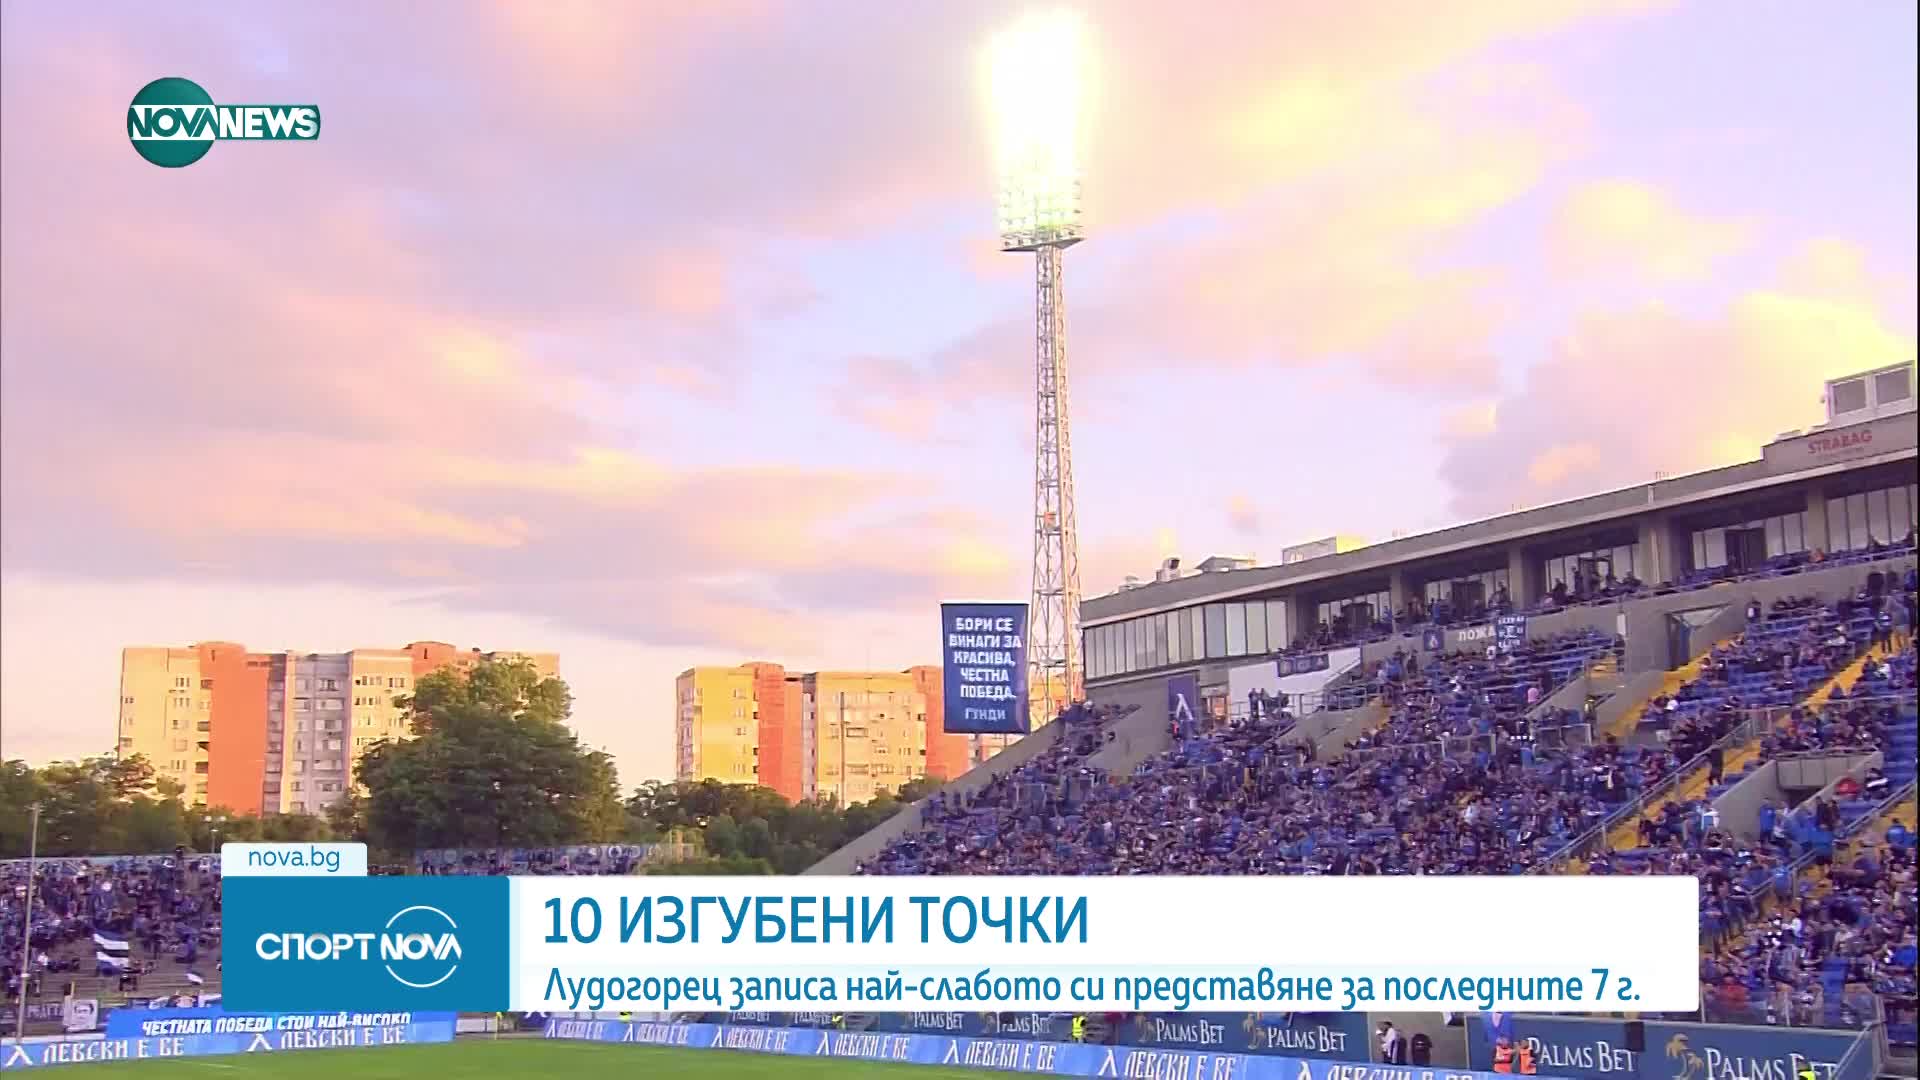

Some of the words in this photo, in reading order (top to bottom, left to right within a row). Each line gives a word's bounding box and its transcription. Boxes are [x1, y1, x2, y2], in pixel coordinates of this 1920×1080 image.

[956, 617, 992, 631] БОРИ
[996, 617, 1014, 631] СЕ
[949, 634, 1000, 648] ВИНАГИ
[1003, 635, 1022, 648] ЗА
[953, 651, 1016, 667] КРАСИВА,
[960, 667, 1010, 681] ЧЕСТНА
[964, 707, 1006, 721] ГУНДИ
[142, 1018, 213, 1036] ЧЕСТНАТА
[215, 1015, 273, 1032] ПОБЕДА
[276, 1014, 315, 1030] СТОИ
[1156, 1018, 1198, 1042] PALMS
[1200, 1019, 1225, 1044] BET
[1267, 1027, 1316, 1050] PALMS
[1318, 1025, 1347, 1052] BET
